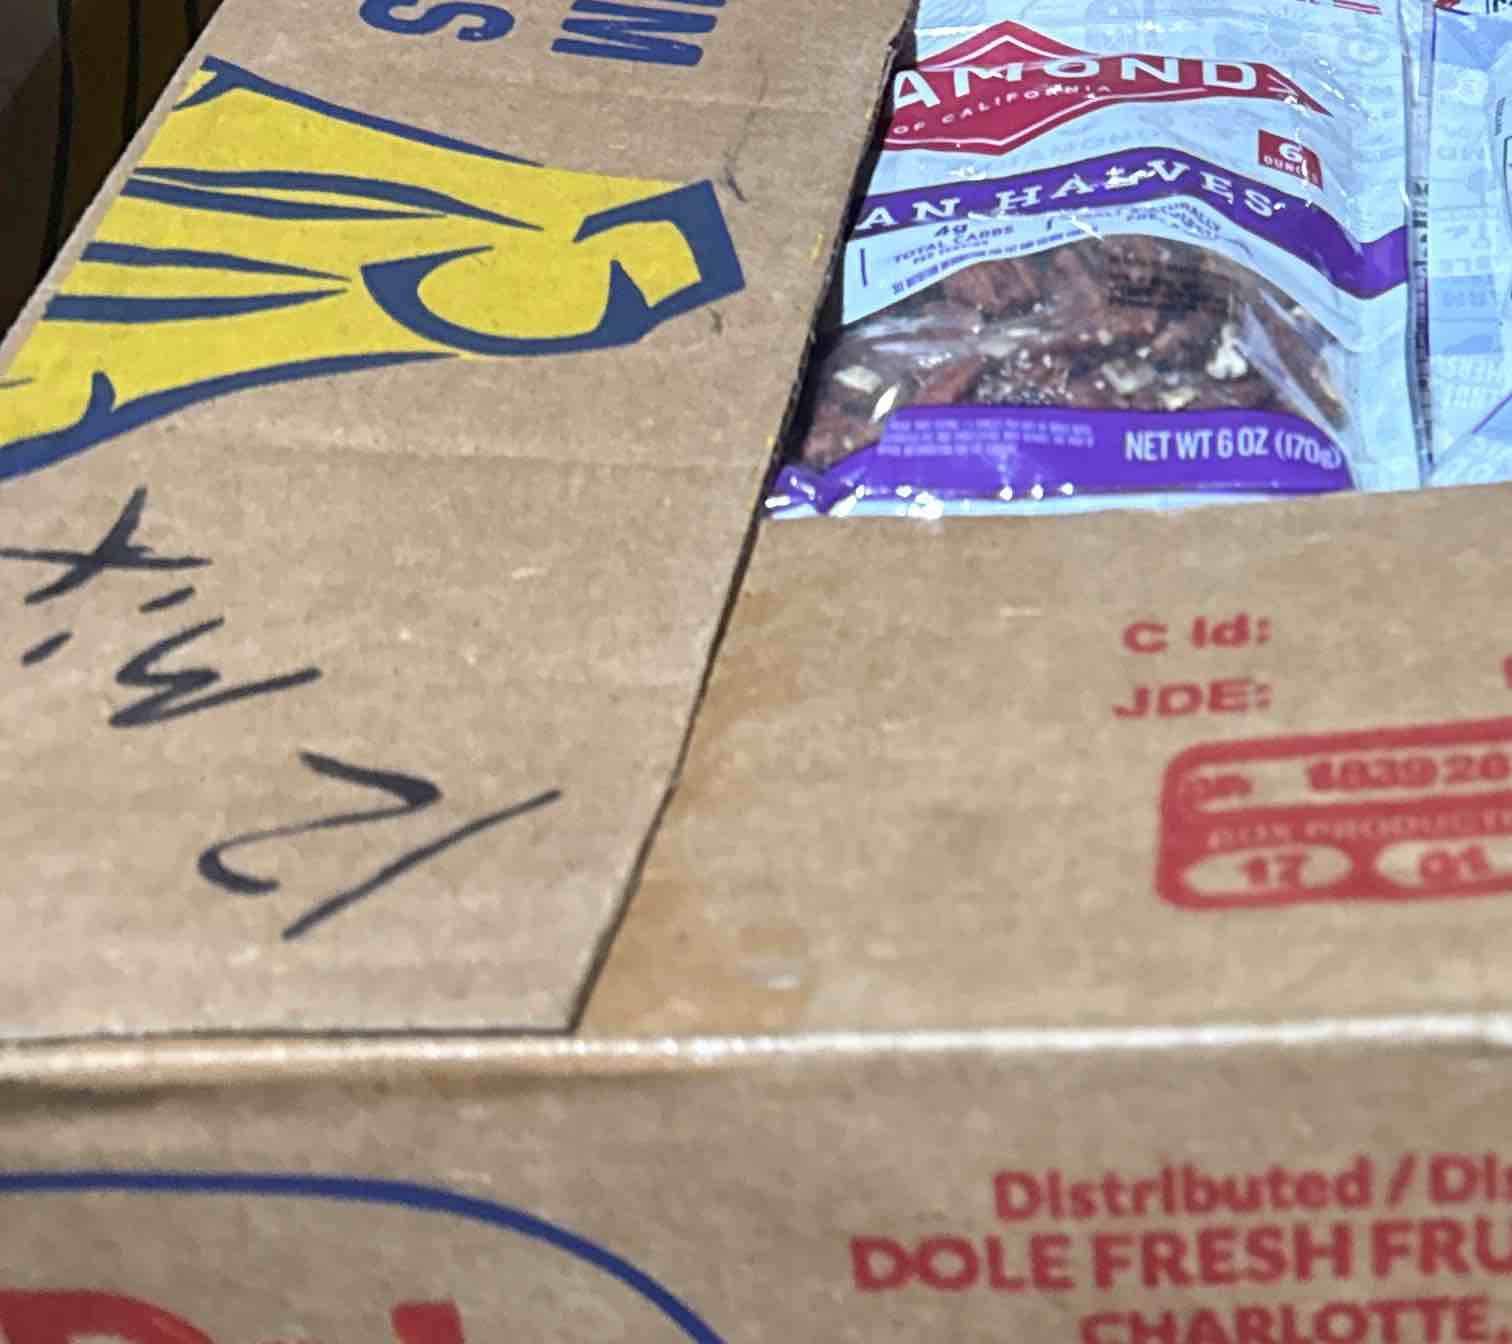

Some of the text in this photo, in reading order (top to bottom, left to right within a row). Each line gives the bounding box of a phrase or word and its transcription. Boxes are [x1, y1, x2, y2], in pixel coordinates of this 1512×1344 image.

[893, 56, 1258, 113] AMOND
[1124, 430, 1173, 463] NET
[1174, 429, 1214, 459] WT
[1217, 427, 1234, 456] 6
[1236, 426, 1271, 457] OZ
[1121, 618, 1170, 655] C
[1112, 678, 1274, 720] JDE:
[992, 1154, 1374, 1223] Distributed
[849, 1233, 1076, 1296] DOLE
[1091, 1219, 1353, 1292] FRESH
